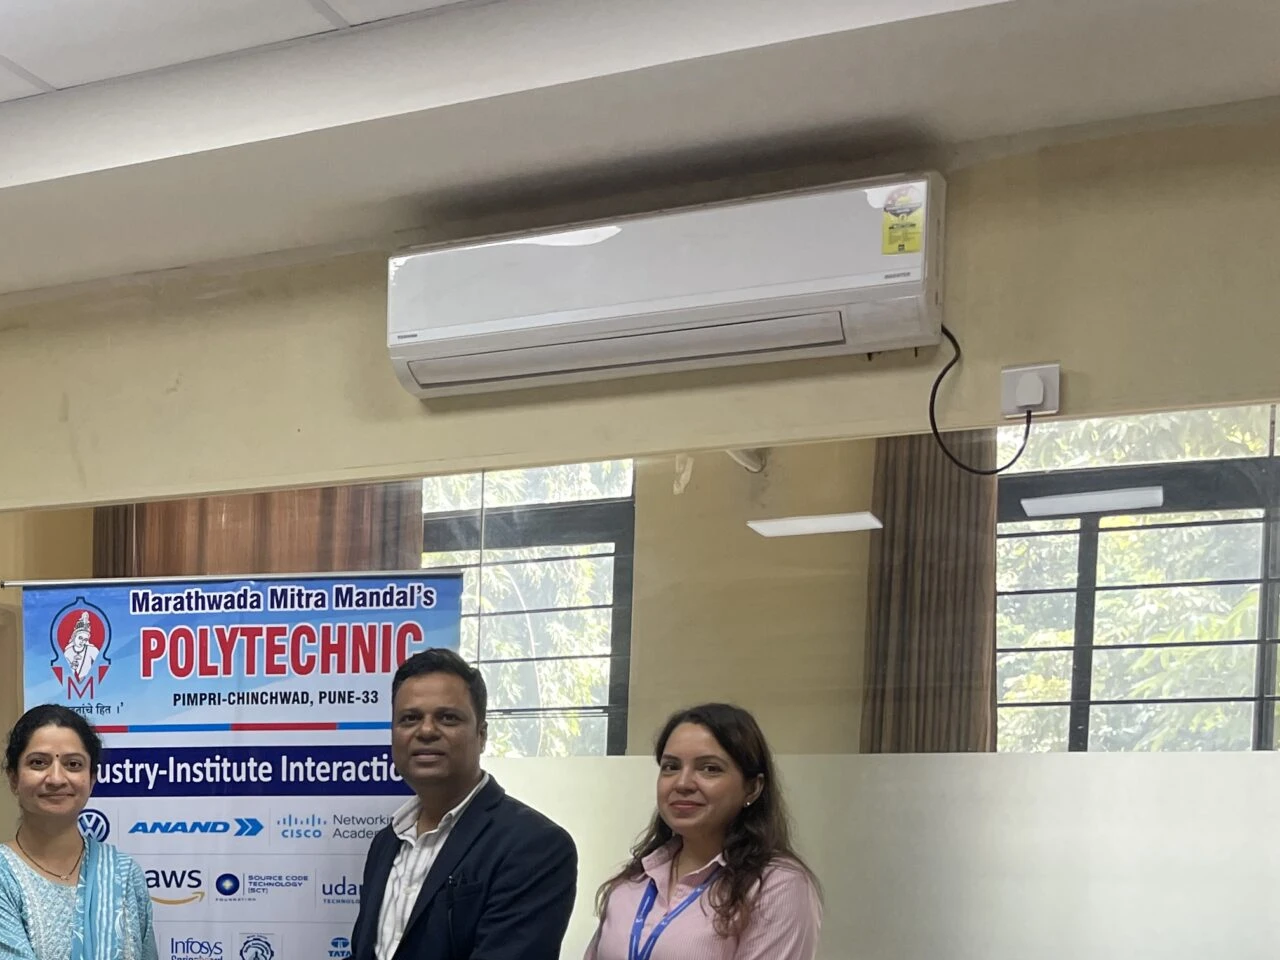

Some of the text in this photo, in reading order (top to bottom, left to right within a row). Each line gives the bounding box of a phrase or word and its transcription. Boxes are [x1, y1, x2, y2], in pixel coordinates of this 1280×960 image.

[130, 584, 435, 614] Marathwada Mitra Mandal's
[140, 622, 424, 679] POLYTECHNIC
[173, 689, 379, 708] PIMPRI-CHINCHWAD, PUNE-33
[128, 821, 231, 834] ANAND
[145, 869, 202, 889] aws
[170, 937, 223, 957] Infosys
